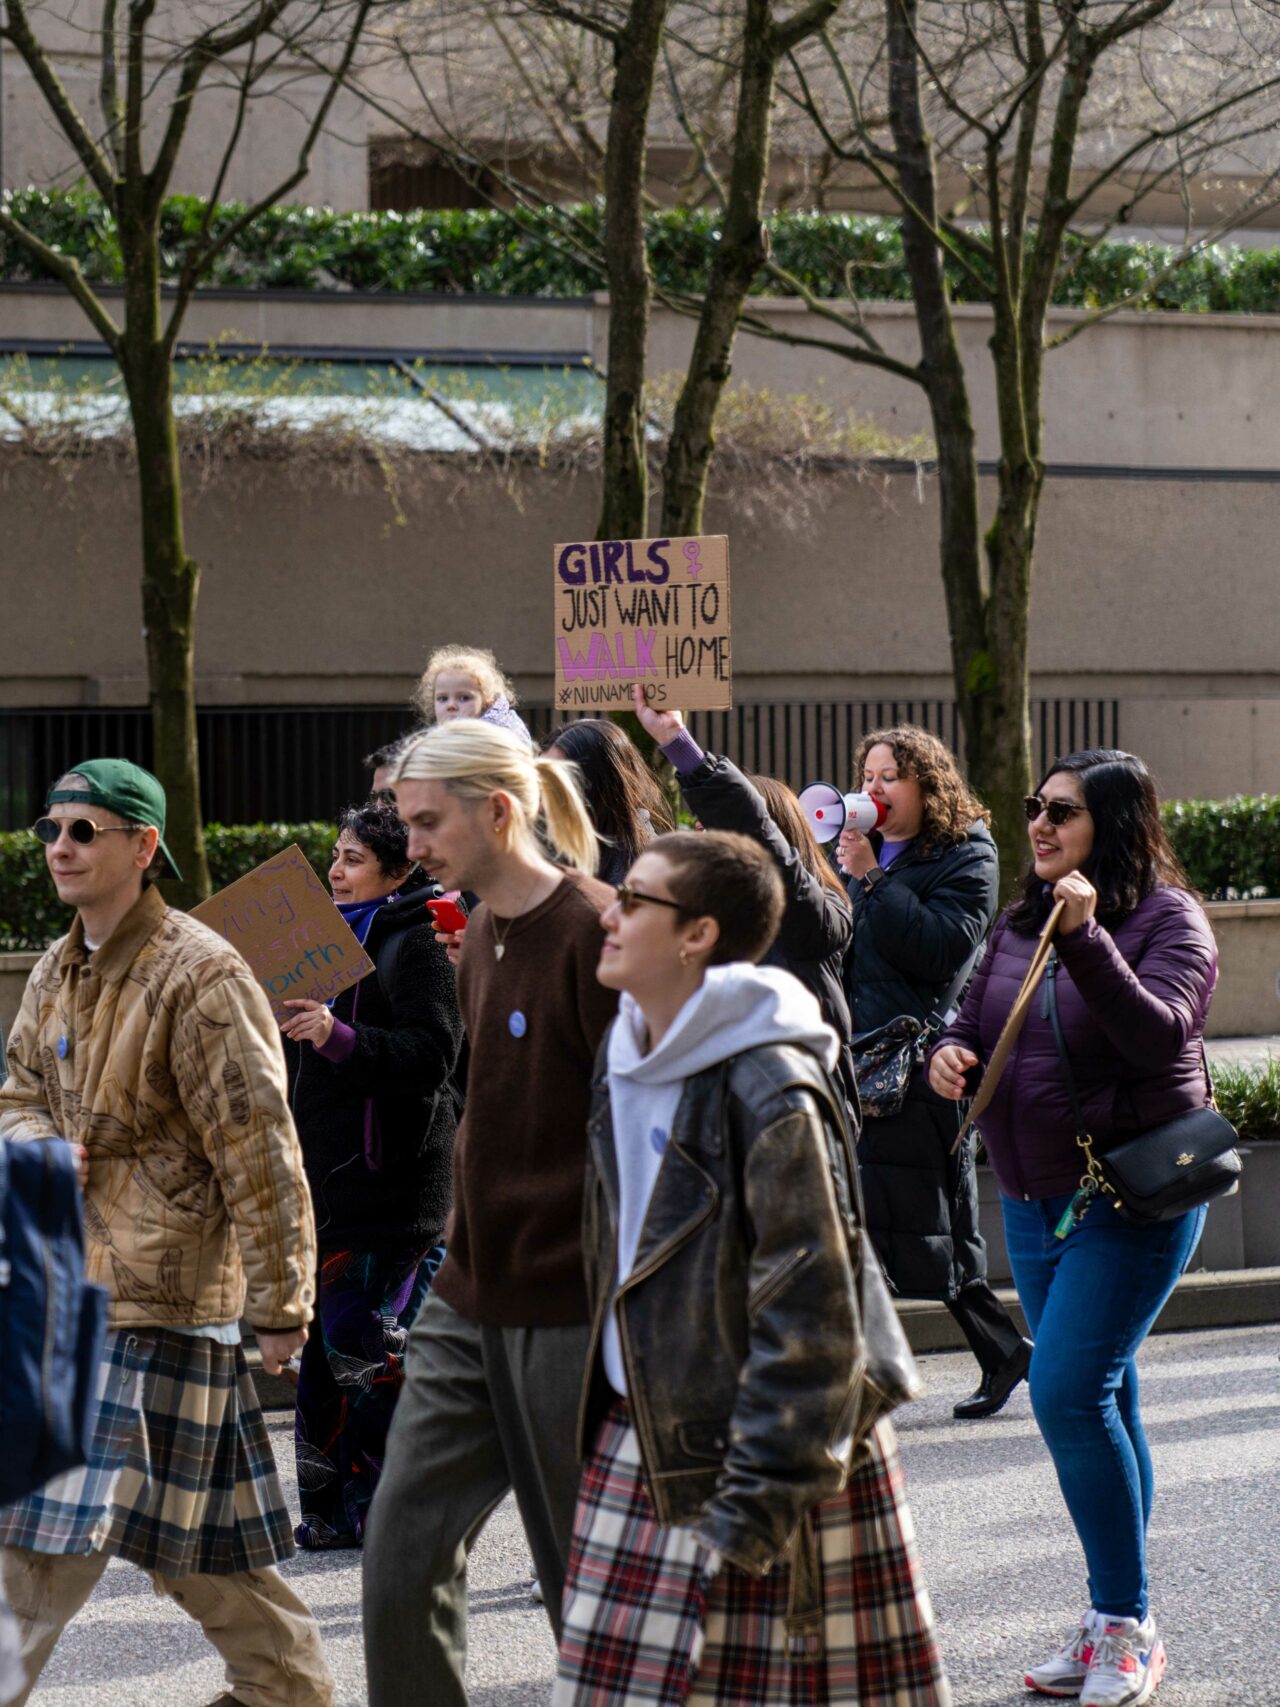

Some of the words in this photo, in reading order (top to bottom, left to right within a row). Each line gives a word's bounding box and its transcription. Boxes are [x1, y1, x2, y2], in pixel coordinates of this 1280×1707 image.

[558, 539, 670, 586] GIRLS
[562, 584, 610, 632] JUST
[614, 584, 682, 627] WANT
[686, 583, 719, 629] TO
[557, 628, 658, 682] WALK
[666, 635, 729, 681] HOME
[559, 682, 667, 704] #NIUNAMEOS
[262, 943, 345, 995] birth
